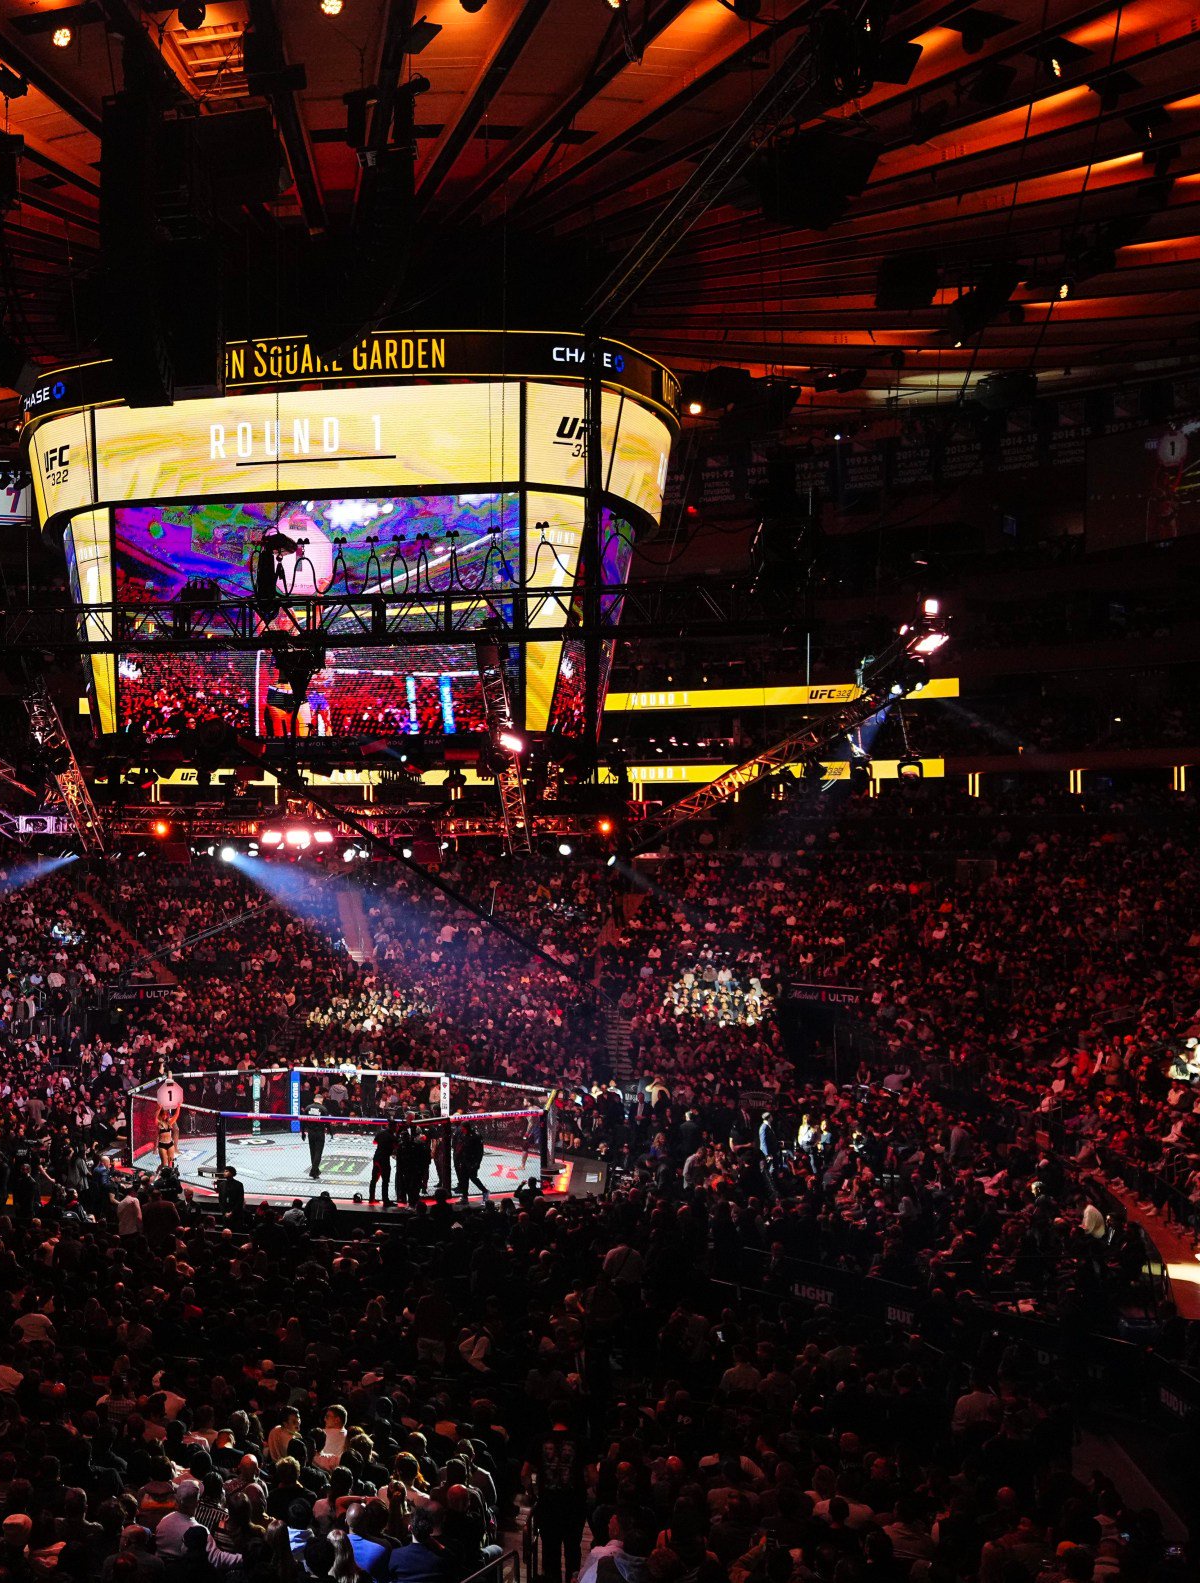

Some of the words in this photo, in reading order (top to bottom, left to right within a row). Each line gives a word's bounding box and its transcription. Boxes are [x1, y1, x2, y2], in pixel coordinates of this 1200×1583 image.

[352, 338, 445, 370] GARDEN
[552, 347, 612, 368] CHE
[210, 417, 340, 460] ROUND
[371, 414, 381, 450] 1
[1169, 441, 1175, 456] 1
[44, 445, 70, 473] UFC
[51, 469, 69, 486] 322
[5, 486, 22, 513] 7
[809, 689, 836, 700] UFC
